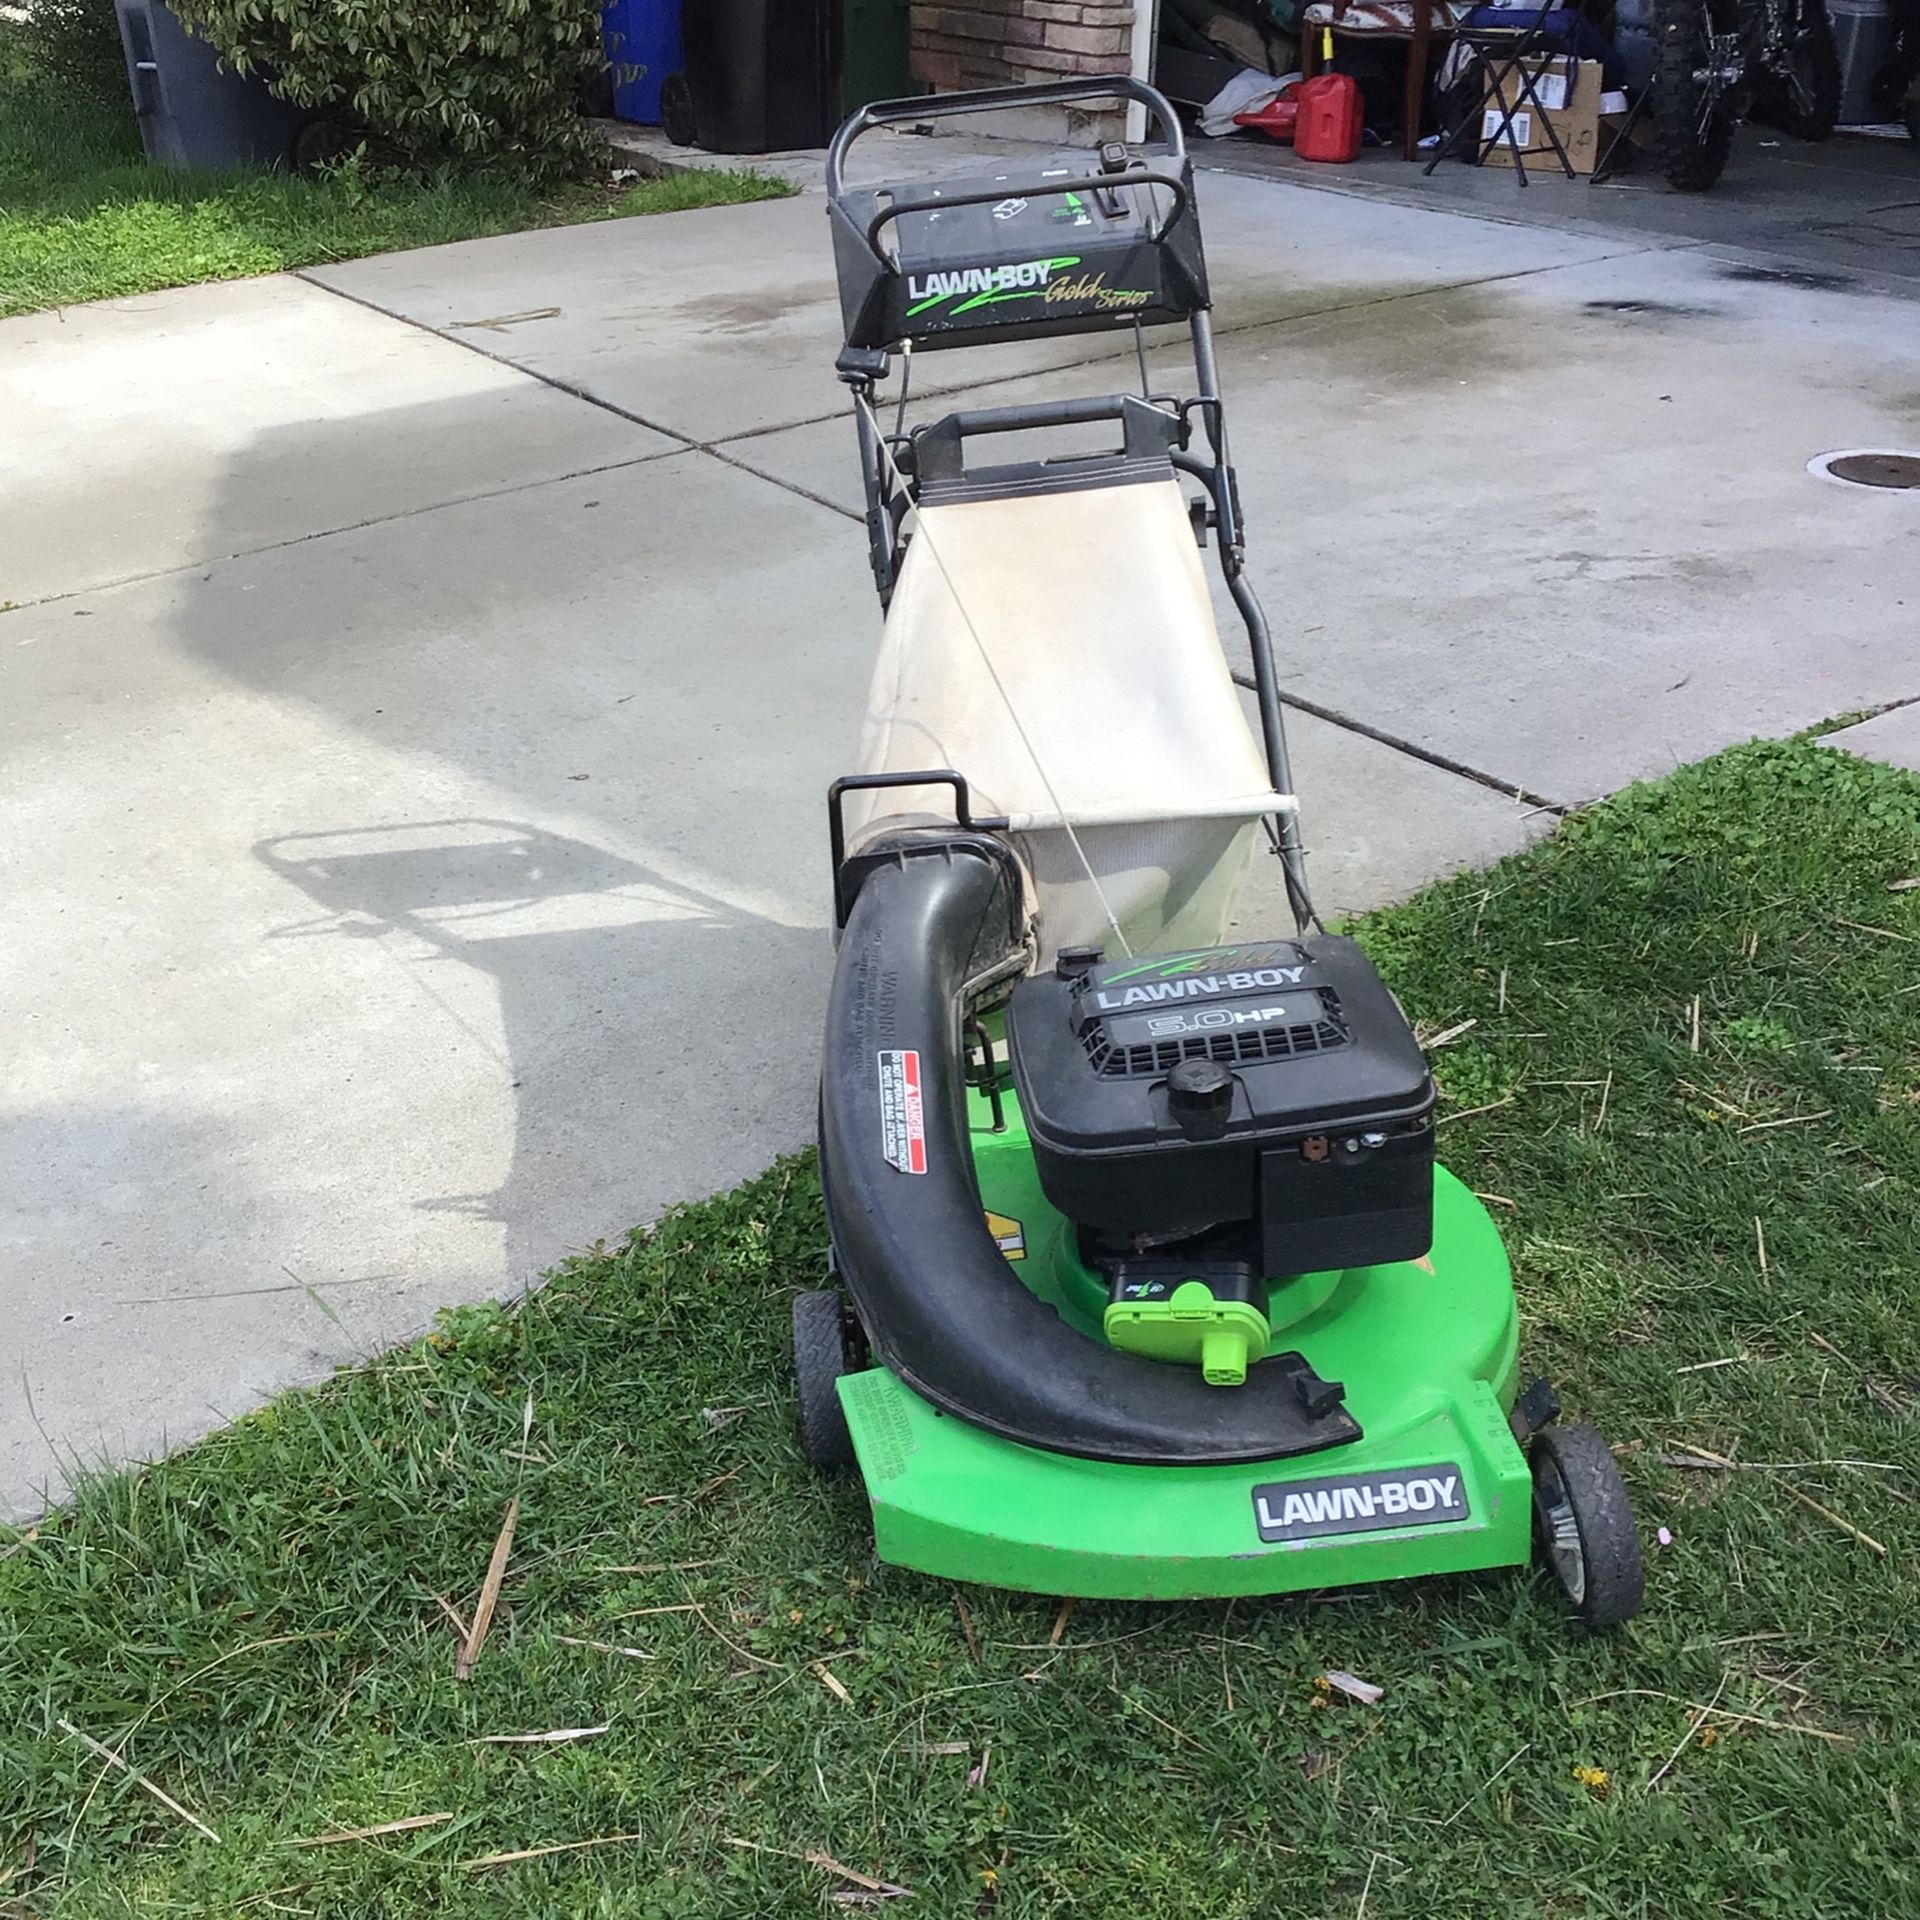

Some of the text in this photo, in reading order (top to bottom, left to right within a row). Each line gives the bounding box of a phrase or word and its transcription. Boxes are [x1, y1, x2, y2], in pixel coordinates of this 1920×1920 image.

[908, 260, 1052, 299] LAWN-BOY
[1044, 272, 1106, 304] Gold
[1095, 288, 1149, 309] Series
[1097, 966, 1304, 1009] LAWN-BOY
[892, 1053, 901, 1063] DO
[883, 1065, 893, 1088] CHUTE
[893, 1064, 902, 1077] NOT
[885, 1089, 894, 1104] AND
[894, 1078, 904, 1110] OPERATE
[886, 1105, 895, 1120] BAG
[907, 1096, 921, 1140] DANGER
